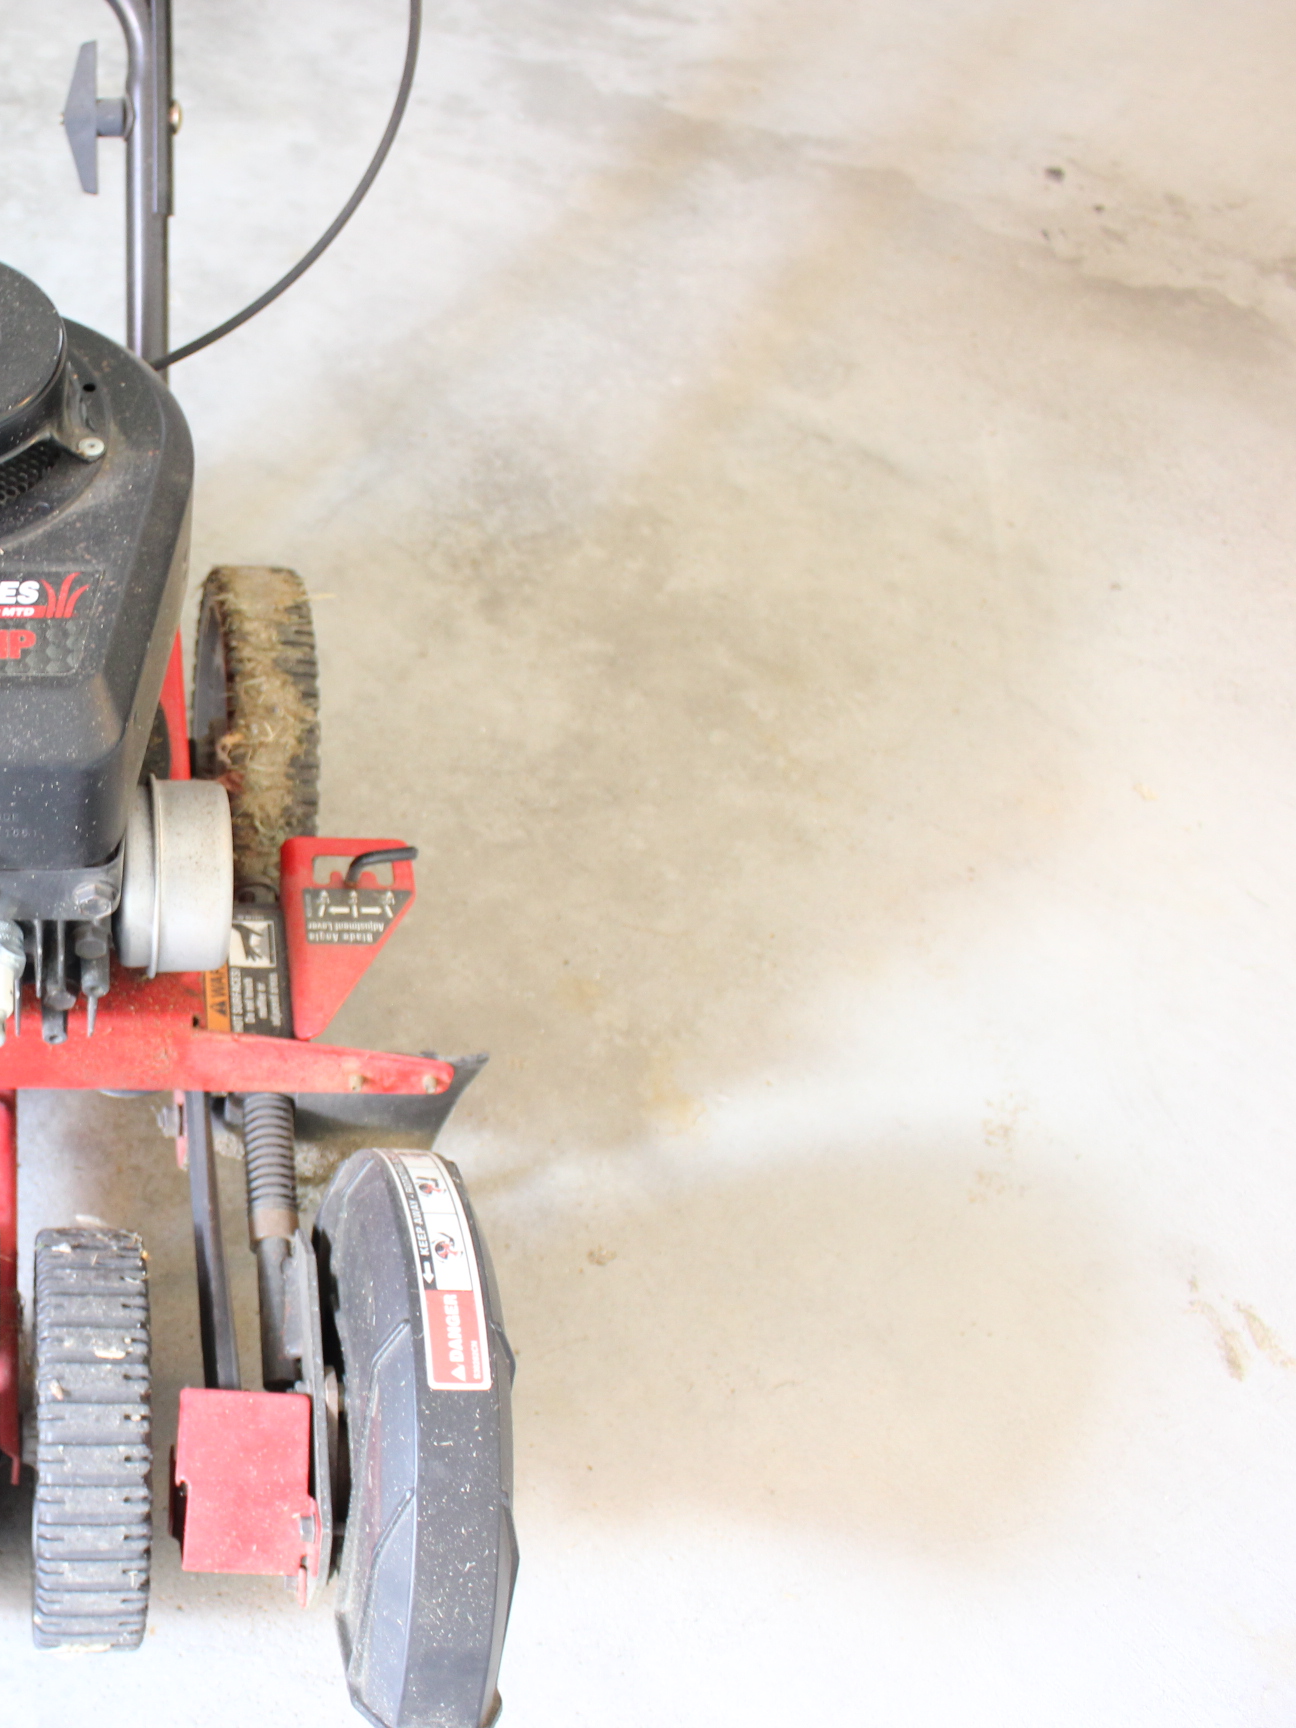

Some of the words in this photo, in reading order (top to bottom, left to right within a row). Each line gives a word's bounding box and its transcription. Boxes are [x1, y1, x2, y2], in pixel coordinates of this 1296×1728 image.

[1, 606, 35, 617] MTD
[334, 921, 385, 932] Adjustment
[308, 930, 339, 943] Angle
[343, 932, 374, 943] Blade
[409, 1199, 424, 1225] AWAY
[416, 1228, 430, 1256] KEEP
[443, 1294, 464, 1361] DANGER
